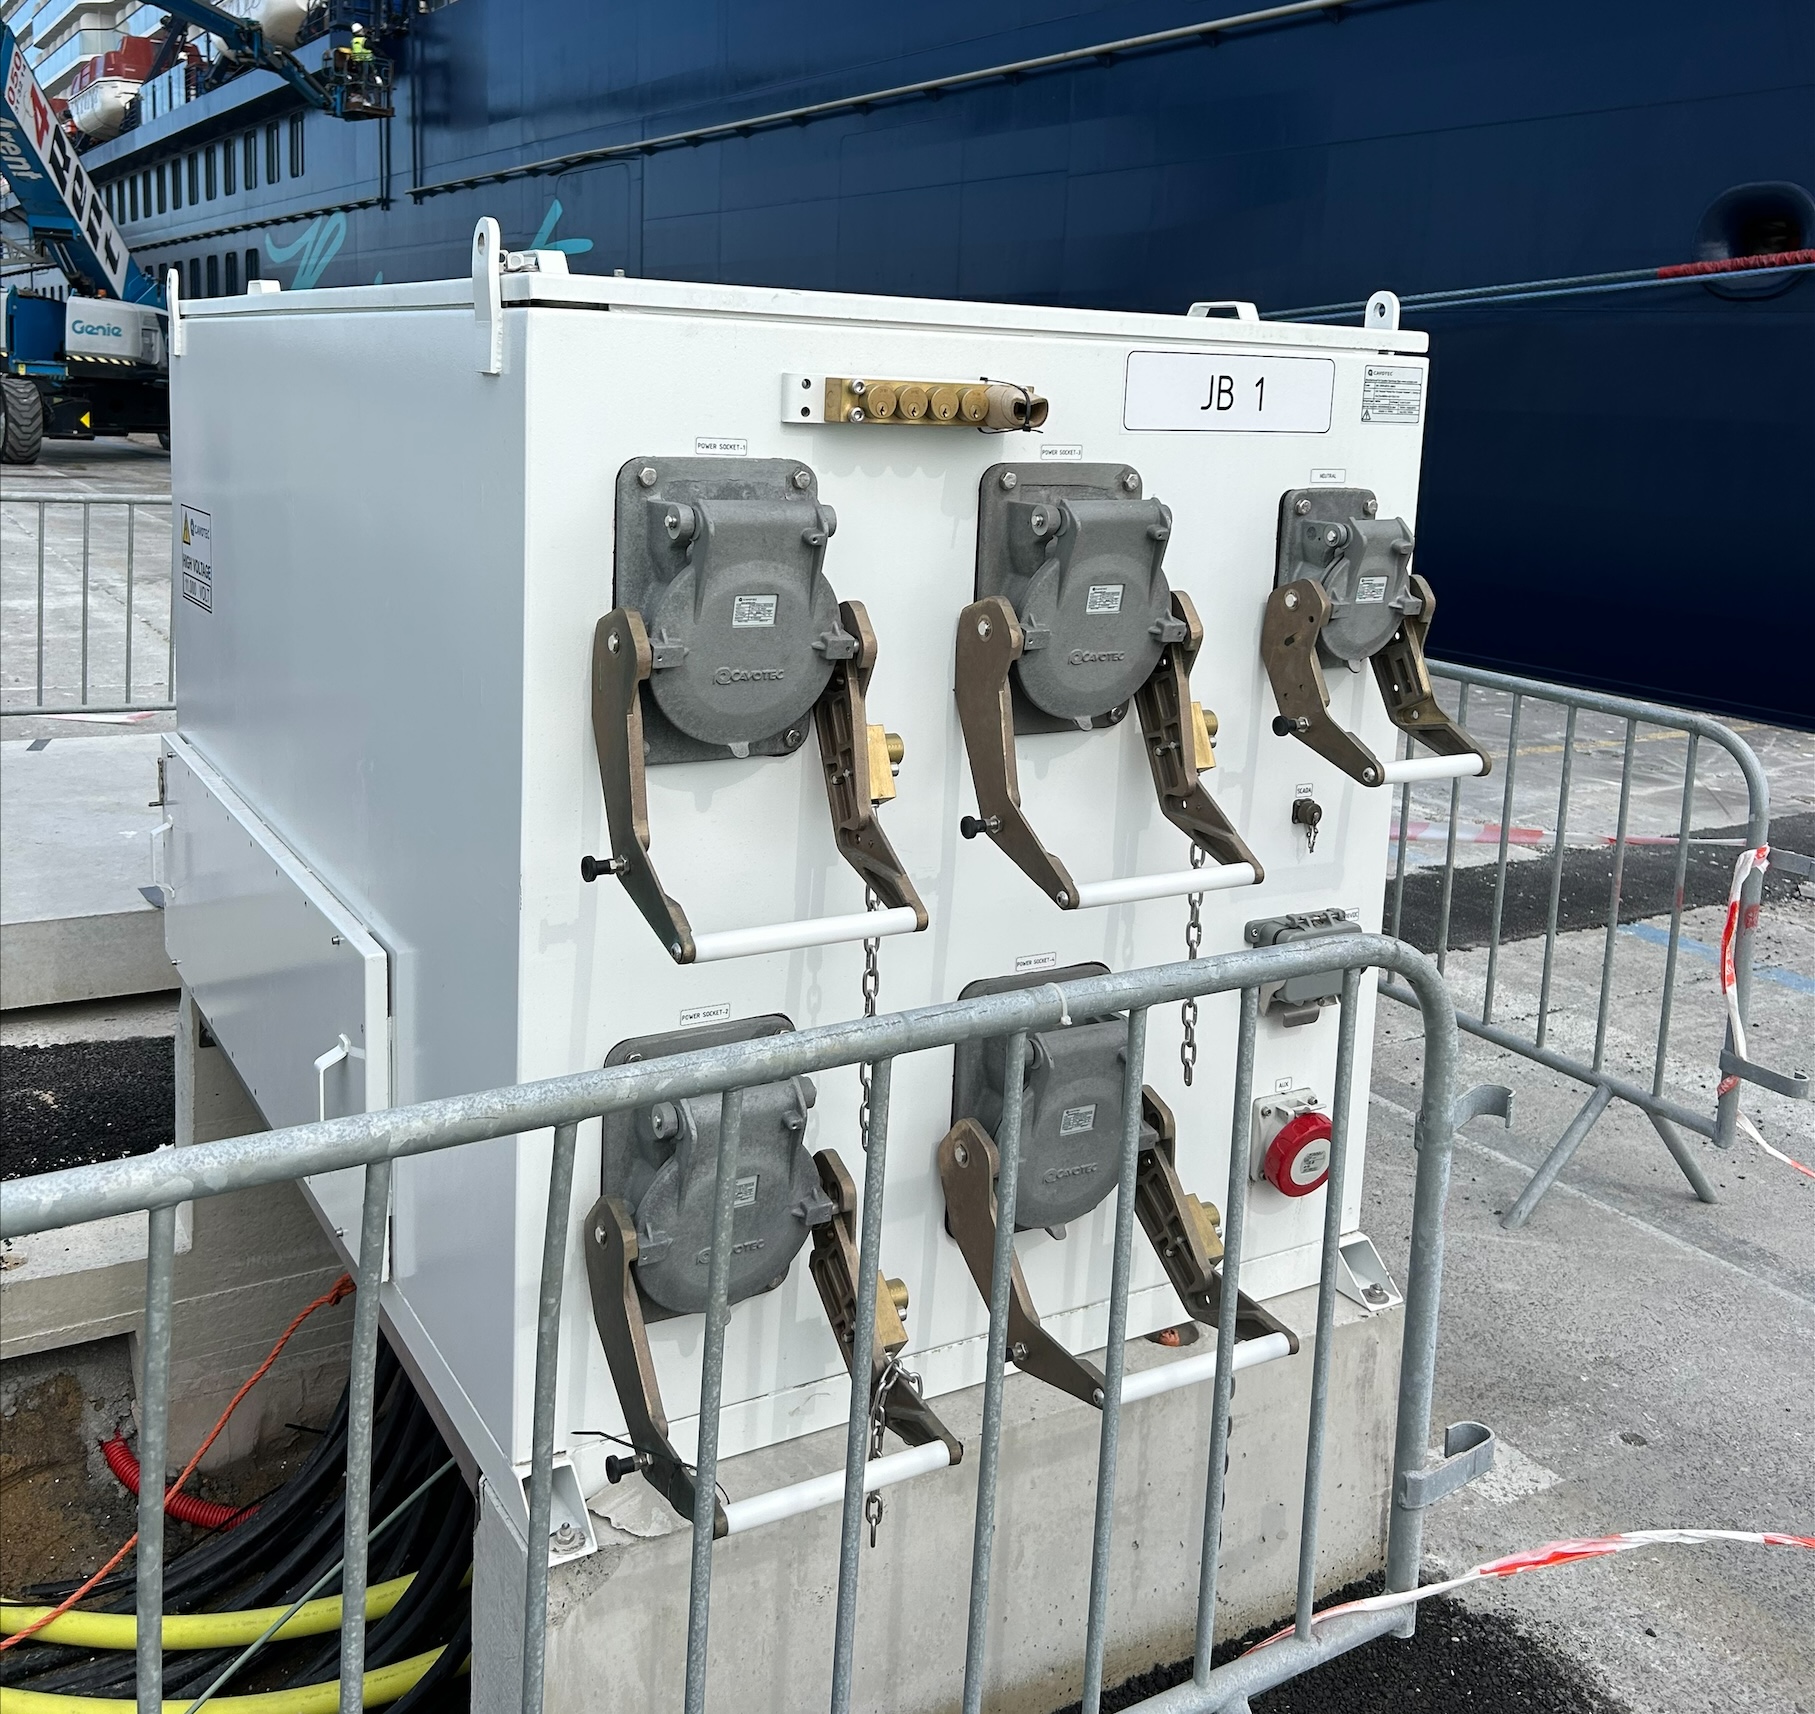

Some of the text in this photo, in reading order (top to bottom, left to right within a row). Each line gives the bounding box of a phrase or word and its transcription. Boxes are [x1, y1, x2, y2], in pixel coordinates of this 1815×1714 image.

[71, 319, 123, 337] Genie
[1200, 374, 1265, 412] JB 1
[697, 442, 717, 450] POWER
[731, 668, 785, 682] CAVOTEC
[681, 1012, 701, 1021] POWER
[1278, 1081, 1289, 1089] AUX
